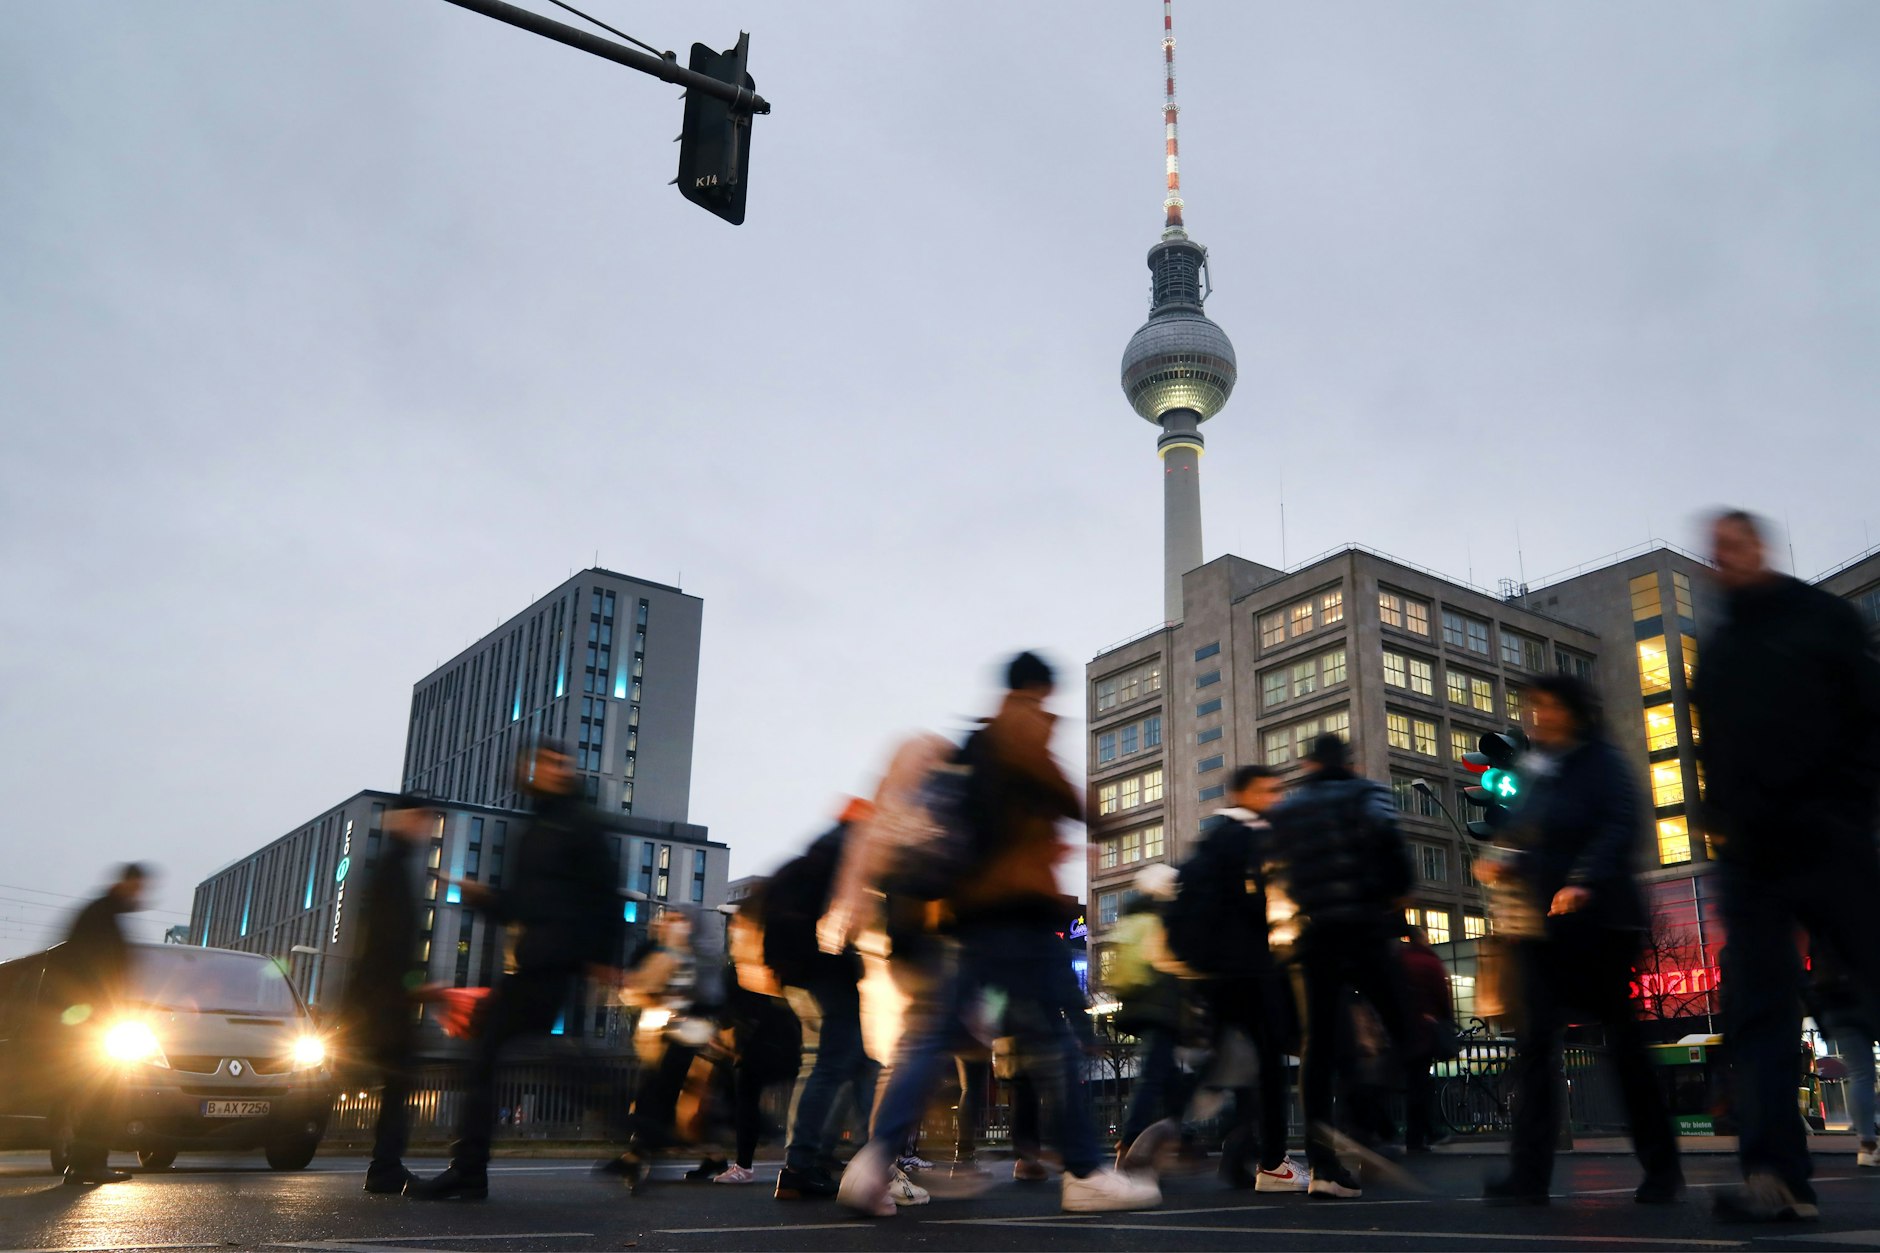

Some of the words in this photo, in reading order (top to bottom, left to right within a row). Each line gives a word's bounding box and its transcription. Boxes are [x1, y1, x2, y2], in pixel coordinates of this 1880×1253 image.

[696, 174, 718, 187] K14
[208, 1103, 216, 1114] B
[223, 1103, 239, 1114] AX
[241, 1103, 268, 1114] 7256
[1680, 1121, 1692, 1129] Wir
[1692, 1121, 1712, 1129] bieten
